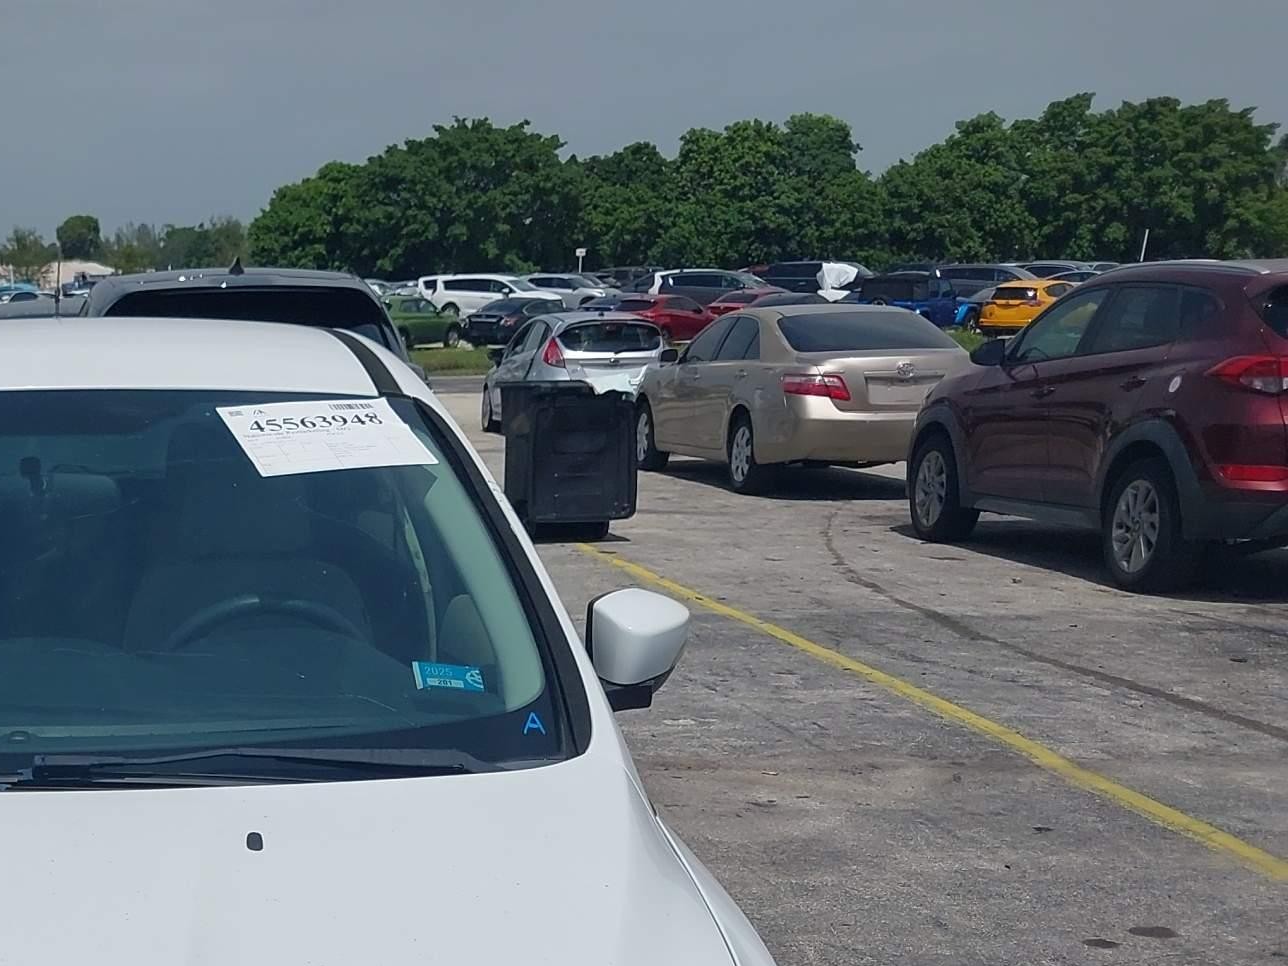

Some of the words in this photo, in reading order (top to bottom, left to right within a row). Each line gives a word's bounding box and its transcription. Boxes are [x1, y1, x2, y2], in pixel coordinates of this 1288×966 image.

[249, 412, 384, 433] 45563948
[424, 666, 453, 676] 2025
[523, 711, 546, 735] A
